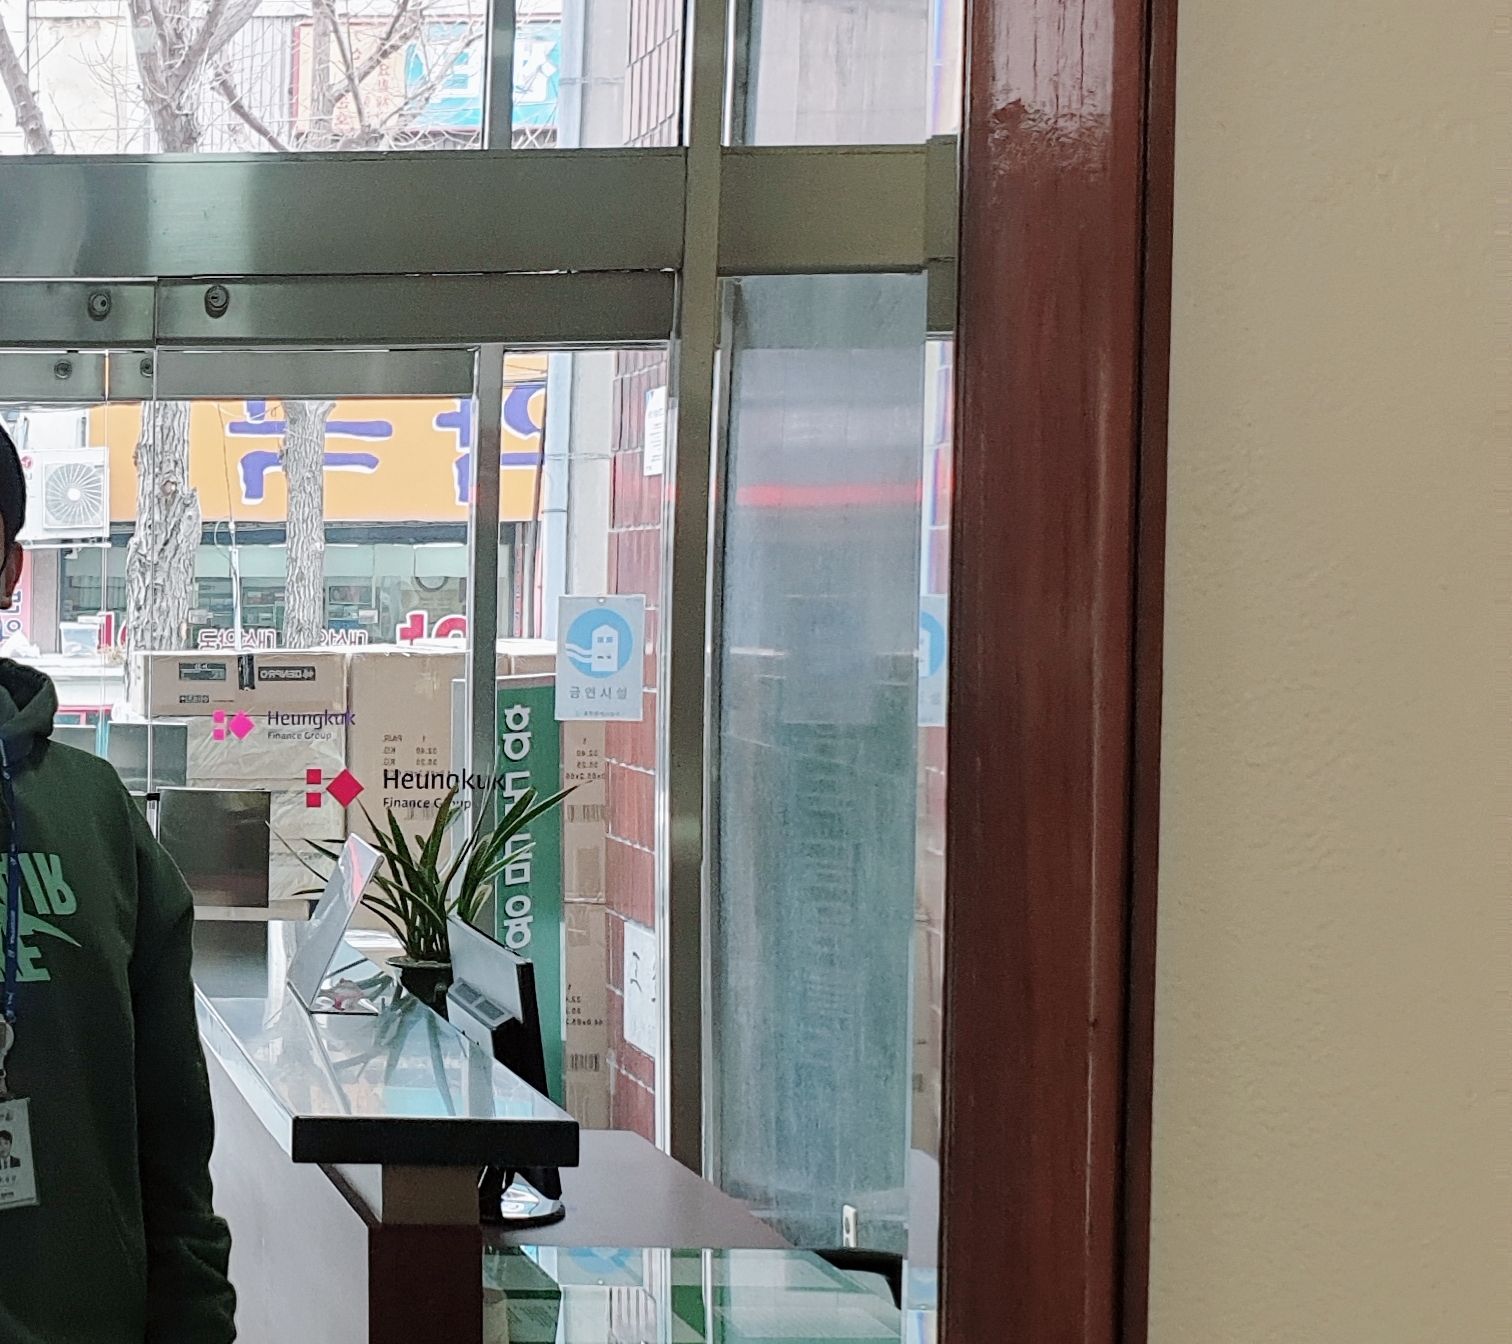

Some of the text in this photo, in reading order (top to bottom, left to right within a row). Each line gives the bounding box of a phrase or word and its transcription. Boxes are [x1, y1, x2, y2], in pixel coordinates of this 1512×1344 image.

[268, 709, 356, 730] Heungkuk
[268, 731, 332, 742] Finance Group
[383, 798, 431, 808] Finance
